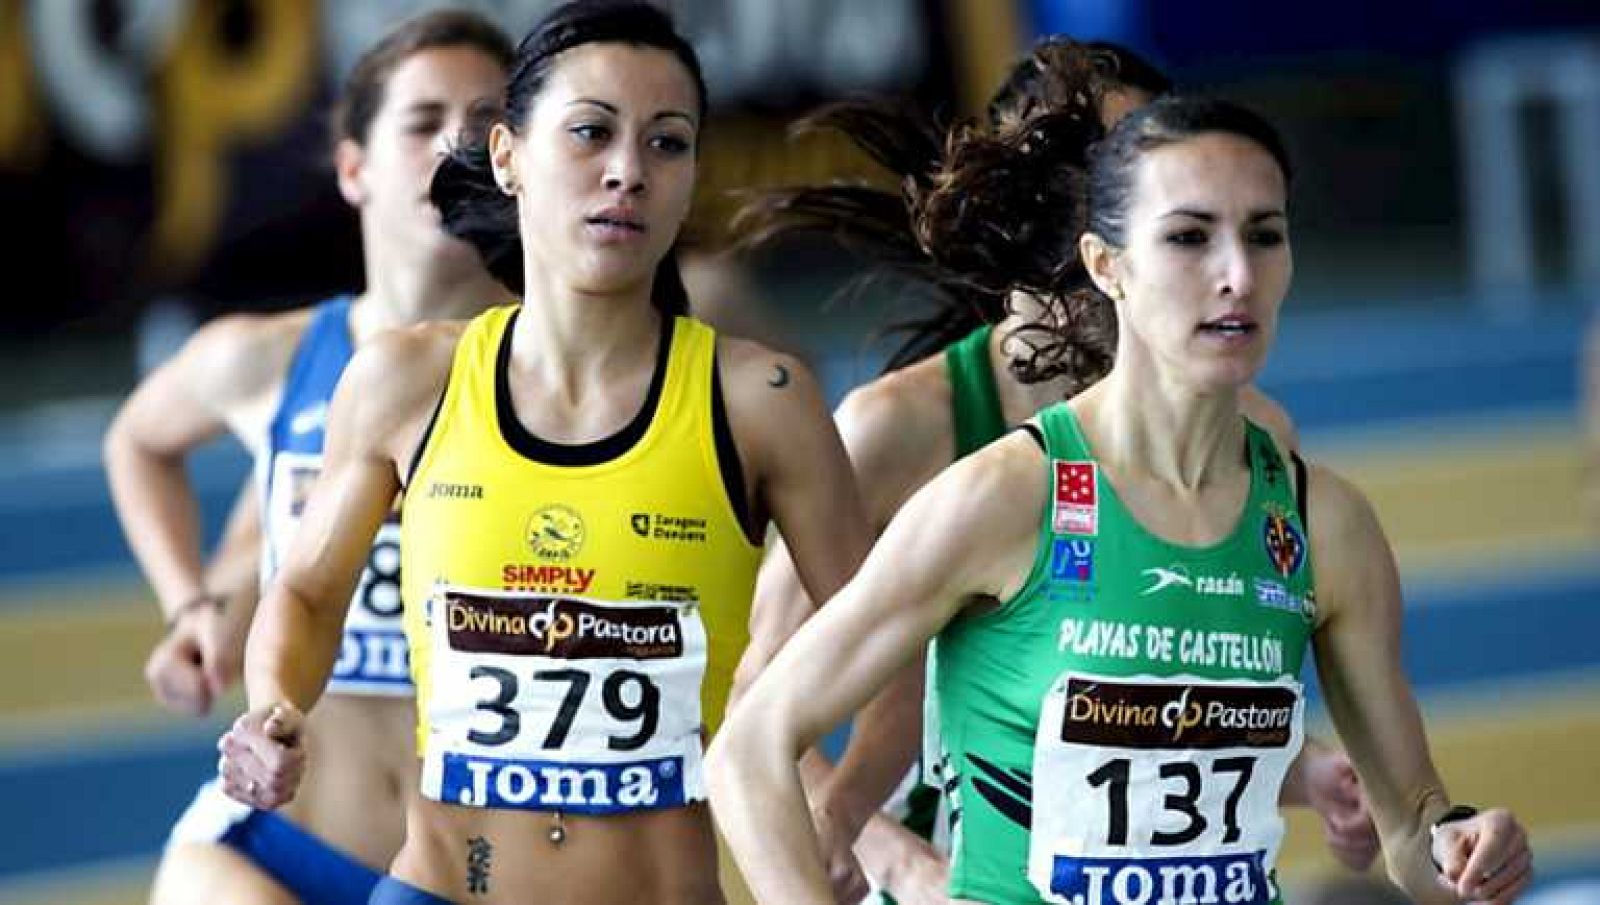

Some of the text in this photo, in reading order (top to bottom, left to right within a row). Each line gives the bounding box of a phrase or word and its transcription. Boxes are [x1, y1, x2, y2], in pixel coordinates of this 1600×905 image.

[448, 605, 526, 634] Divina
[577, 612, 676, 644] Pastora
[1058, 617, 1140, 660] PLAYAS
[1145, 625, 1174, 663] DE
[466, 665, 660, 751] 379
[1070, 694, 1157, 727] Divina
[1205, 701, 1290, 731] Pastora
[1086, 756, 1258, 846] 137
